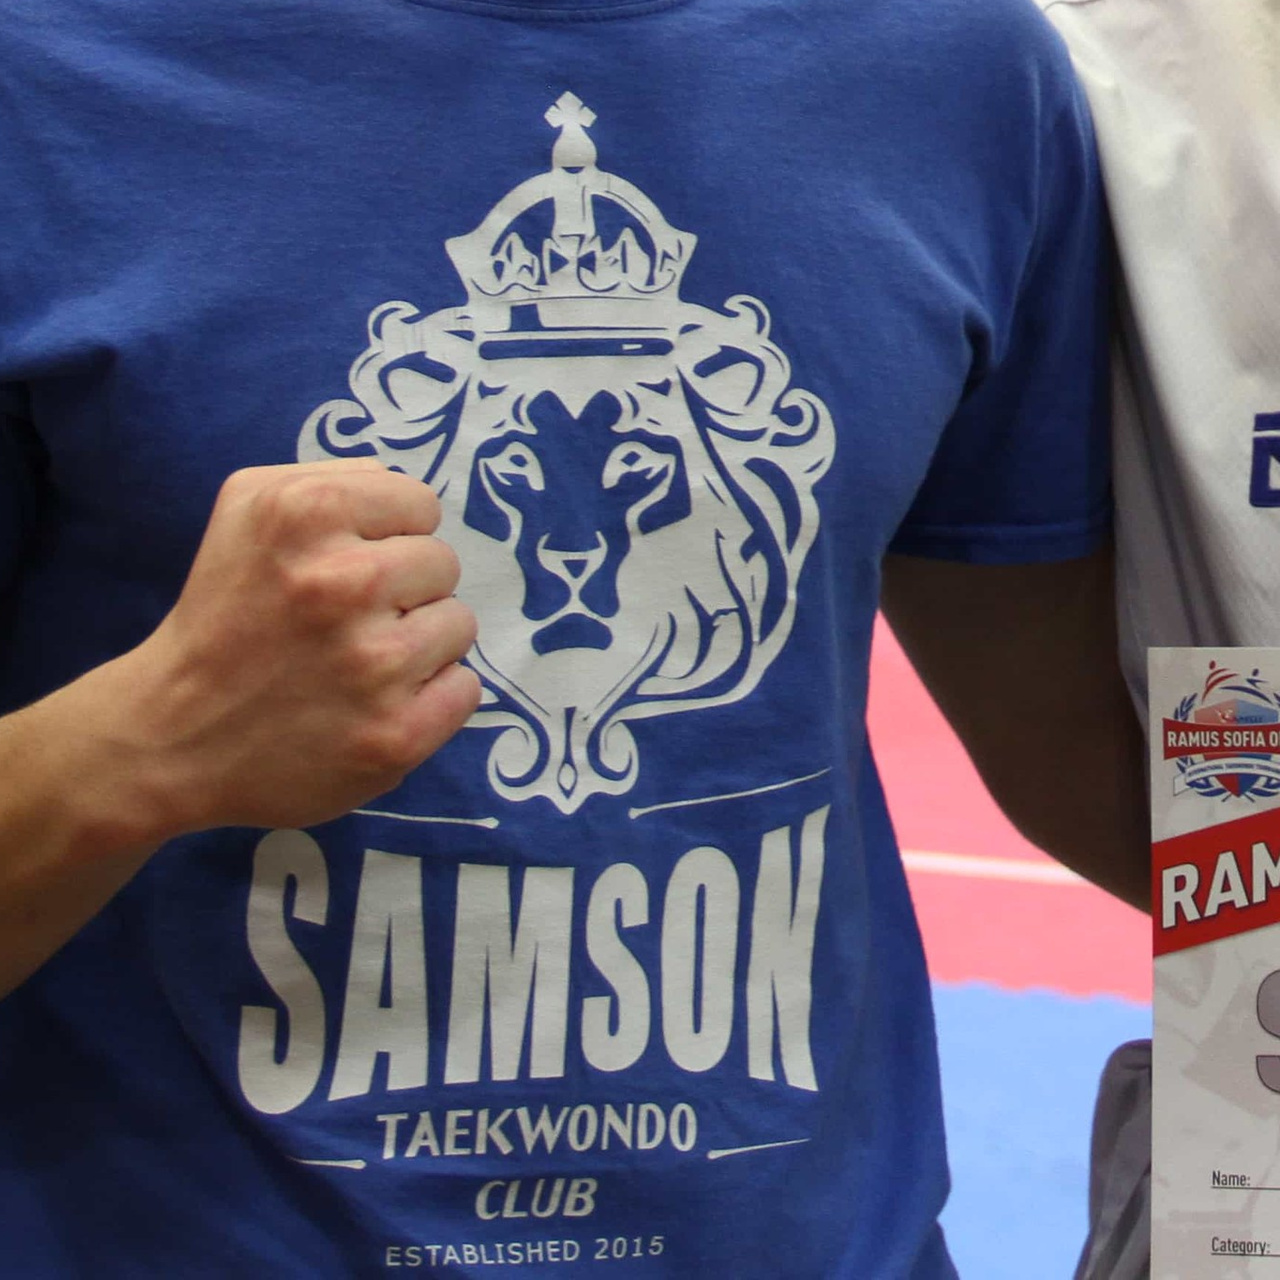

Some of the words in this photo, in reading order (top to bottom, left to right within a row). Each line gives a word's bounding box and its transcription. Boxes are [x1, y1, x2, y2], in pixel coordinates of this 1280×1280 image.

[1167, 730, 1220, 747] RAMUS
[1223, 730, 1266, 747] SOFIA
[236, 804, 831, 1114] SAMSON
[377, 1102, 698, 1160] TAEKWONDO
[1211, 1170, 1251, 1187] Name:
[475, 1177, 598, 1220] CLUB
[385, 1238, 580, 1268] ESTABLISHED
[594, 1235, 666, 1260] 2015
[1211, 1236, 1271, 1256] Category:
